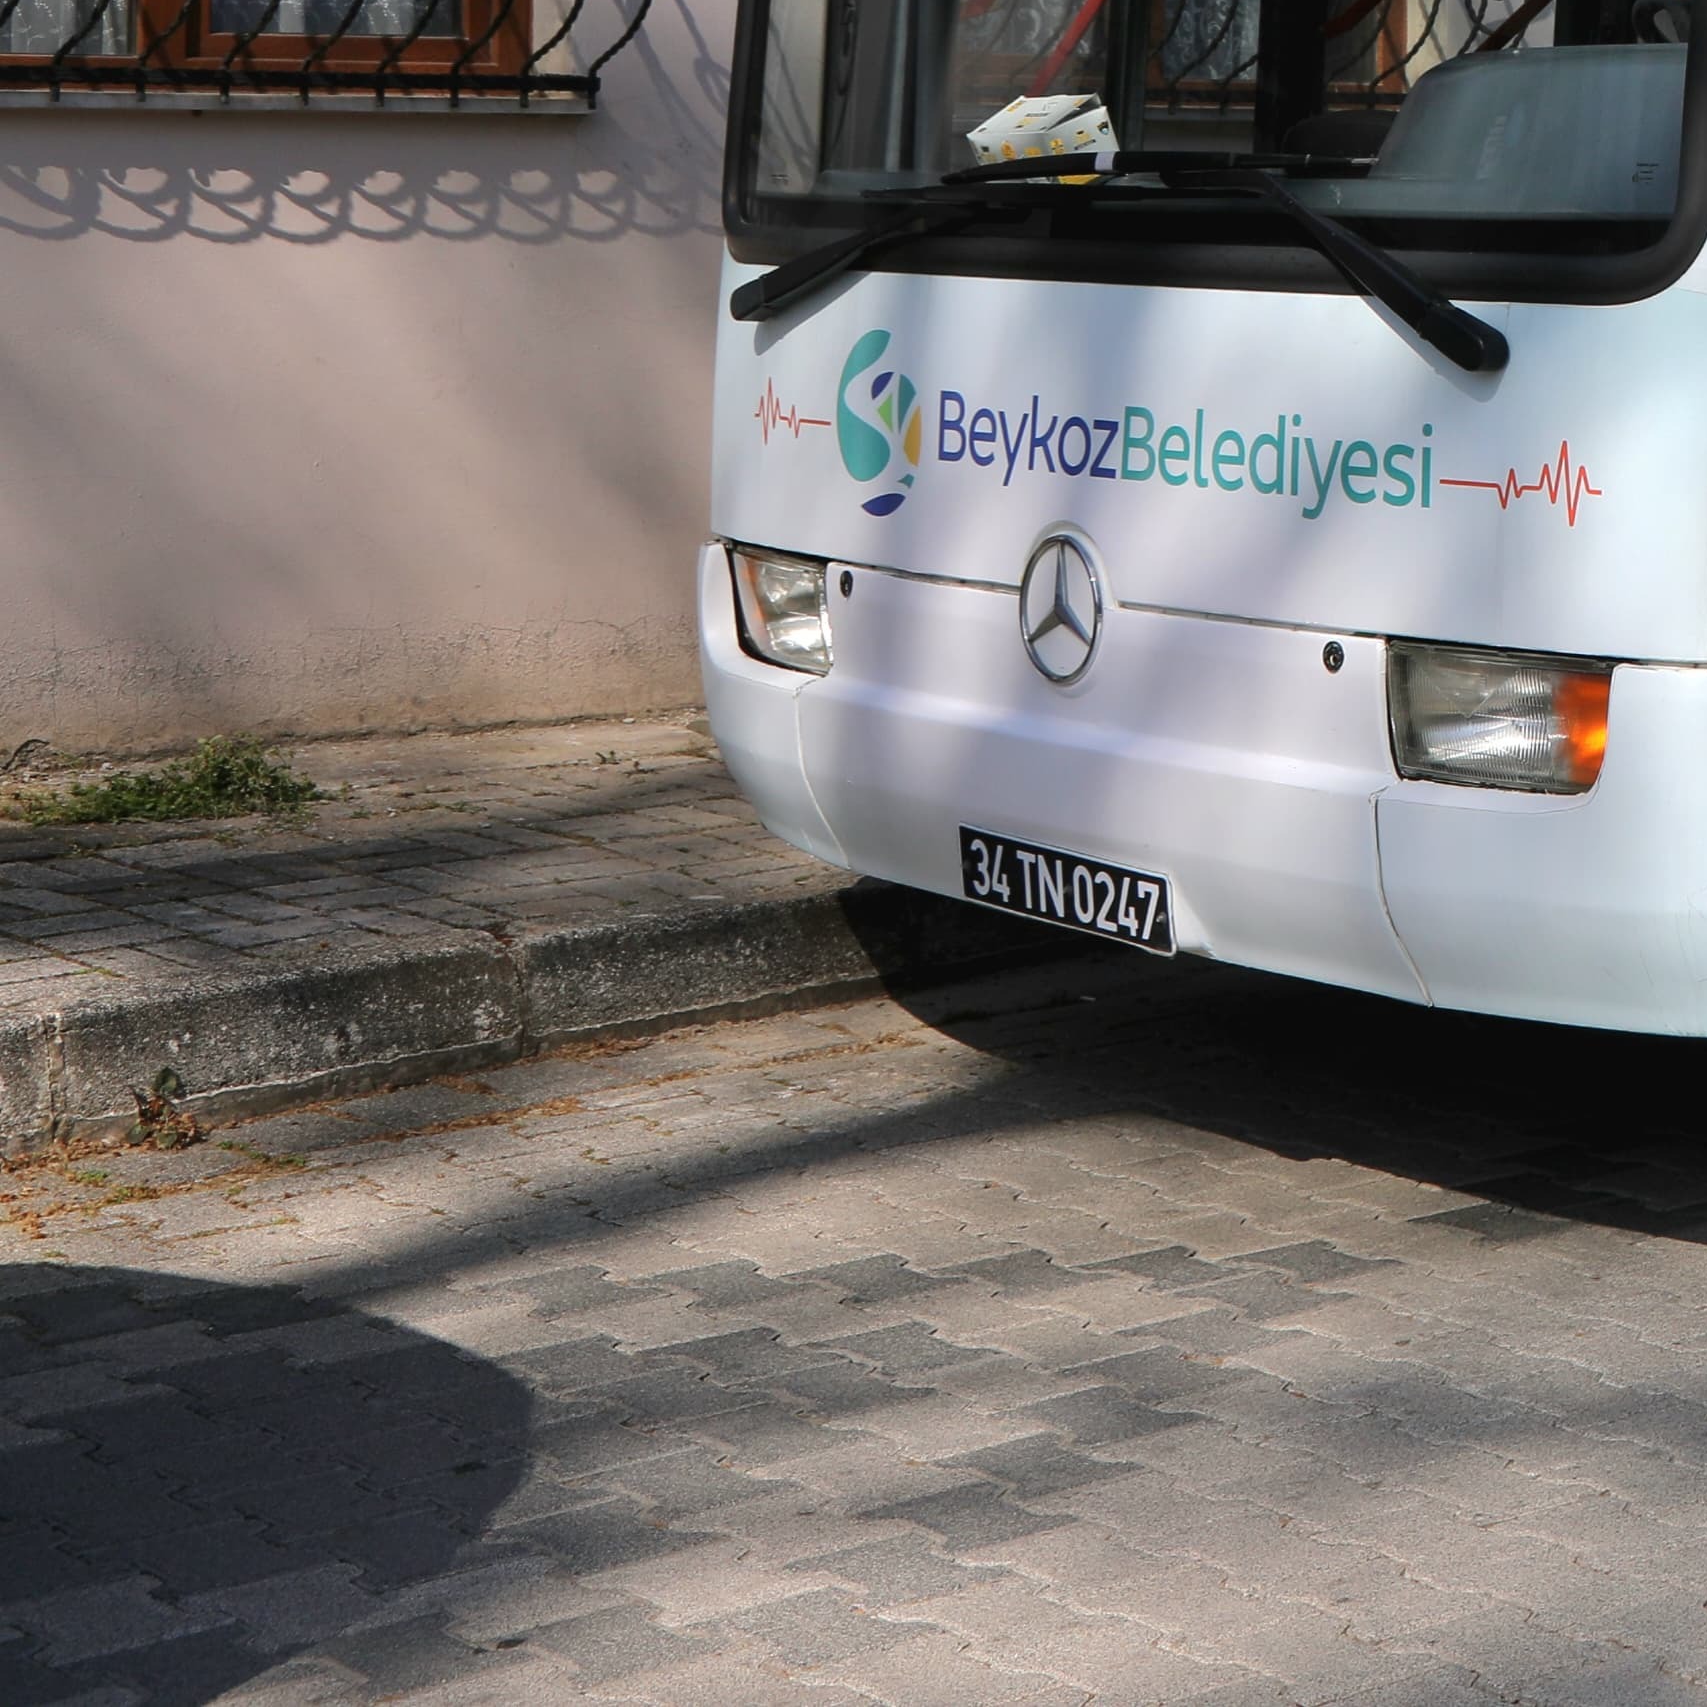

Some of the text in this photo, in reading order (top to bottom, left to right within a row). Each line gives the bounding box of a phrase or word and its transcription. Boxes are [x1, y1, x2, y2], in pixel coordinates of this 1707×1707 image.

[970, 838, 1160, 941] 34 TN 0247
